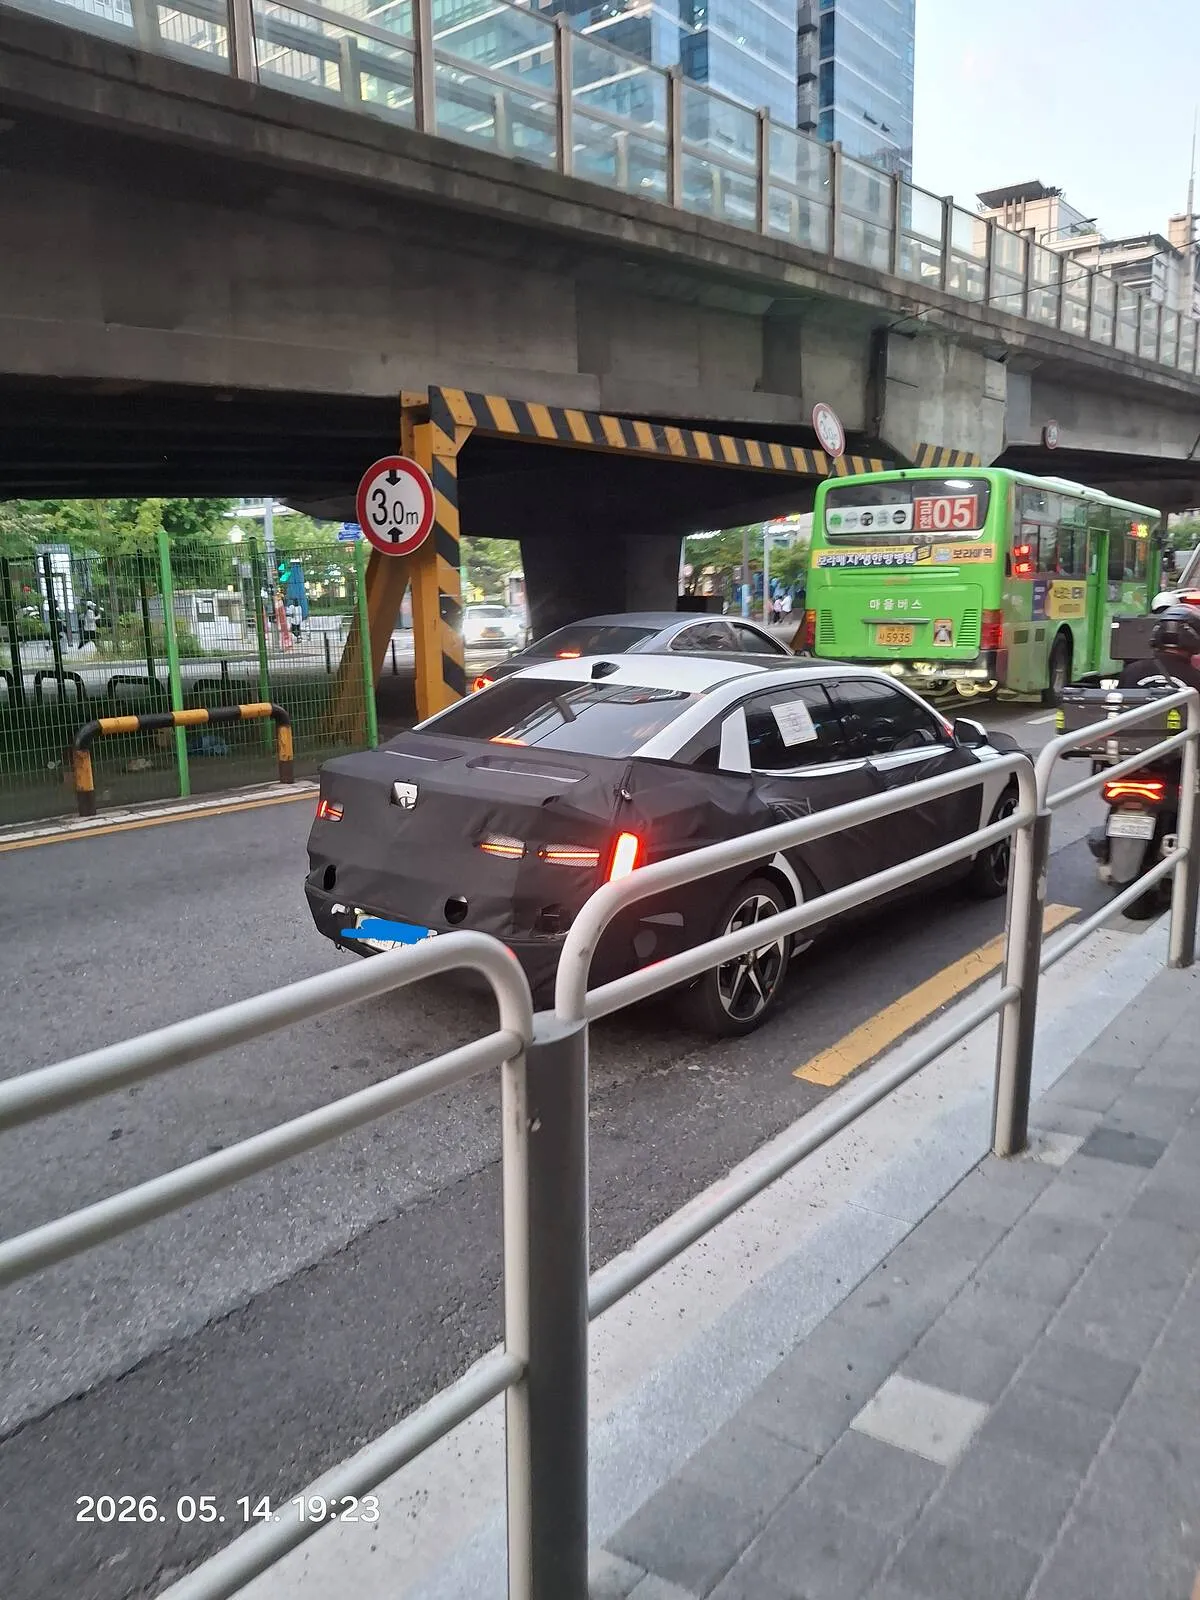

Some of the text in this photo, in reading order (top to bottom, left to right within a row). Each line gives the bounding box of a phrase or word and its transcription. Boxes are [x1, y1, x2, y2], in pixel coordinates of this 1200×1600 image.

[372, 488, 419, 526] 3.0m
[933, 499, 972, 529] 05
[869, 598, 922, 610] 마을버스
